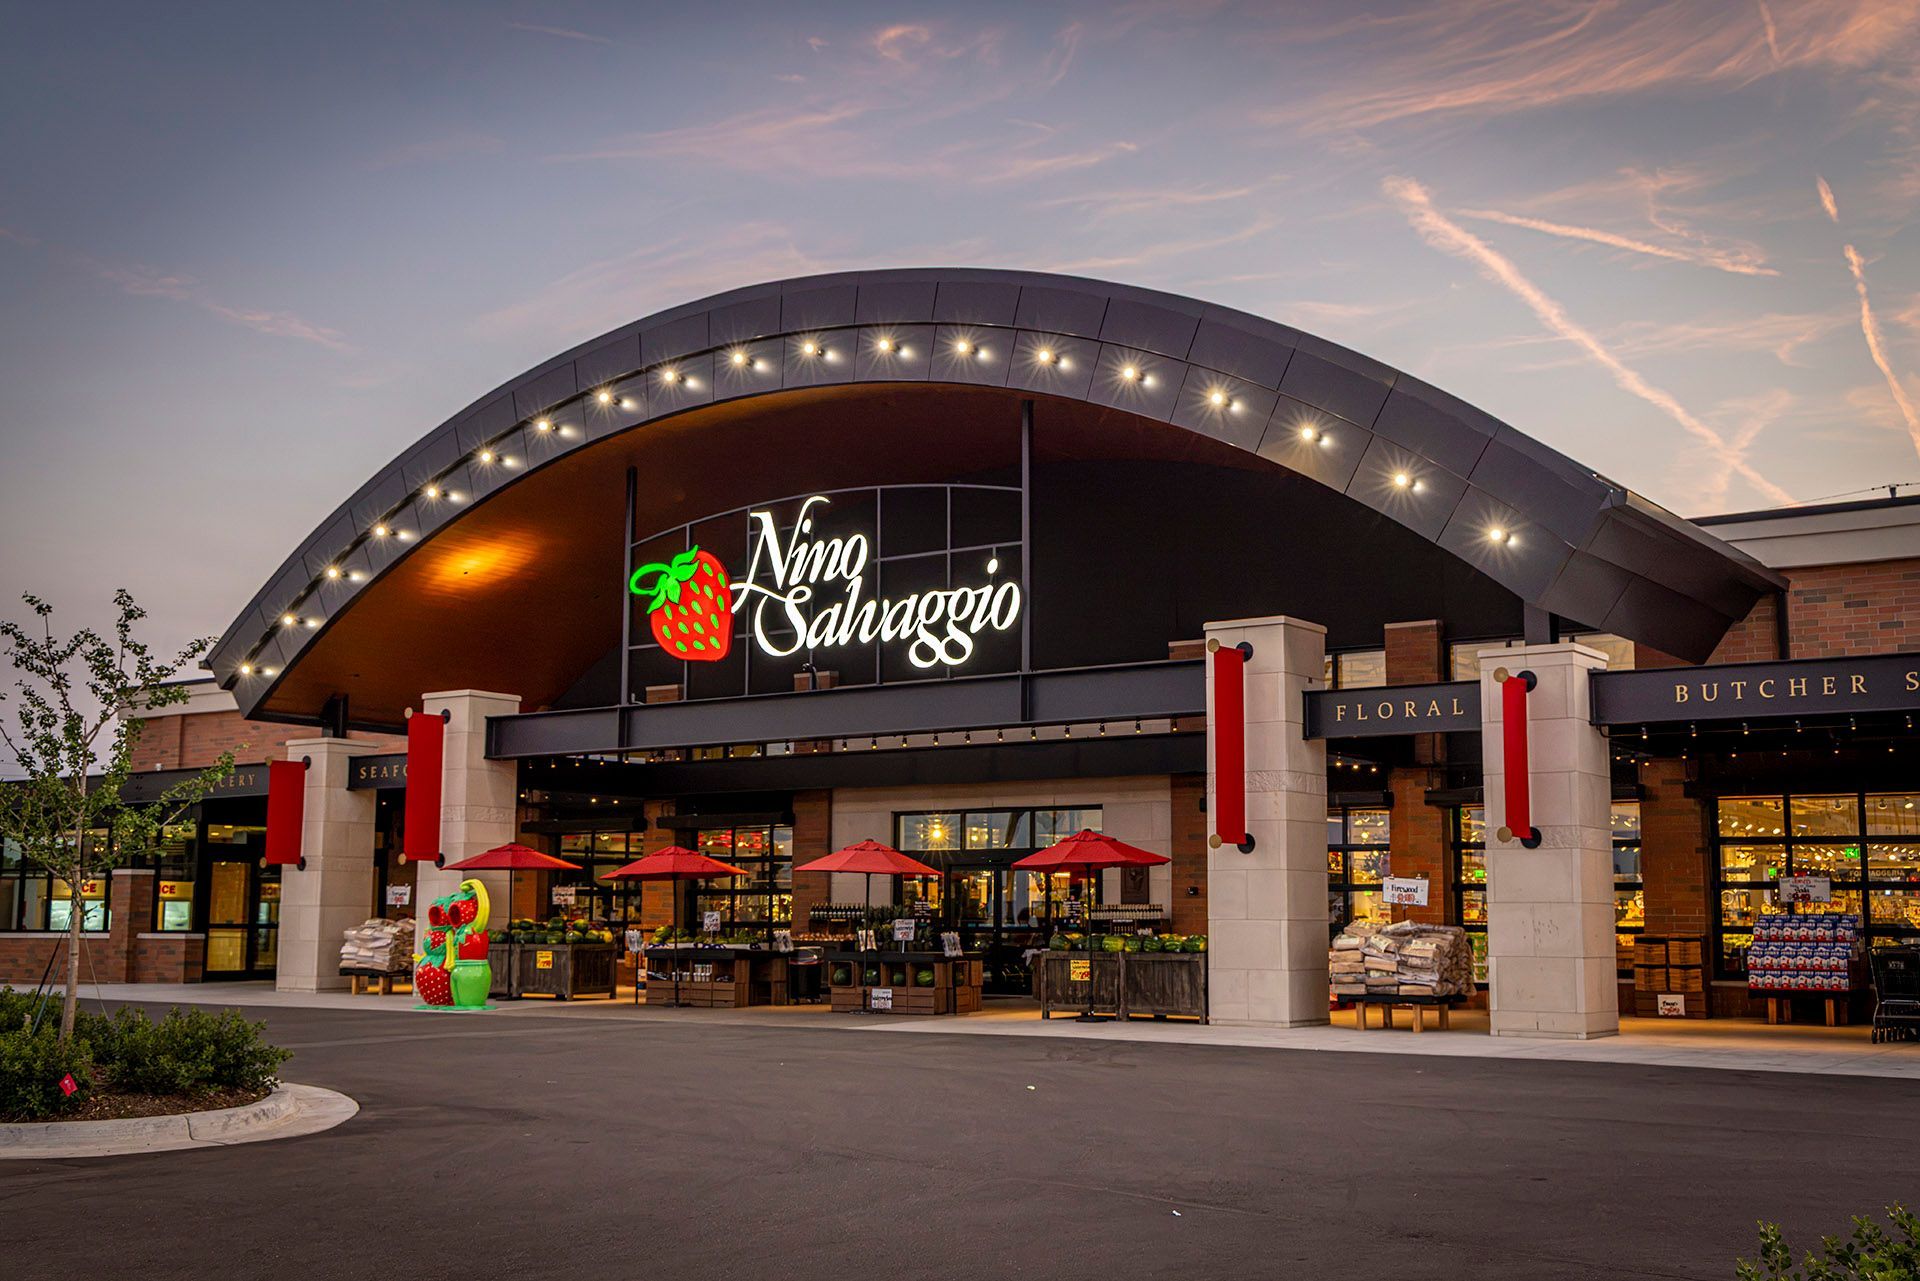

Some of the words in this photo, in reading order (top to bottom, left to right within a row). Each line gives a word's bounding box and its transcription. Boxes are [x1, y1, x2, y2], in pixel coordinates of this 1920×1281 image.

[730, 496, 867, 614] Nino
[754, 558, 1021, 669] Salvaggio
[1675, 674, 1868, 704] BUTCHER
[1336, 698, 1465, 722] FLORAL
[81, 883, 97, 894] CE
